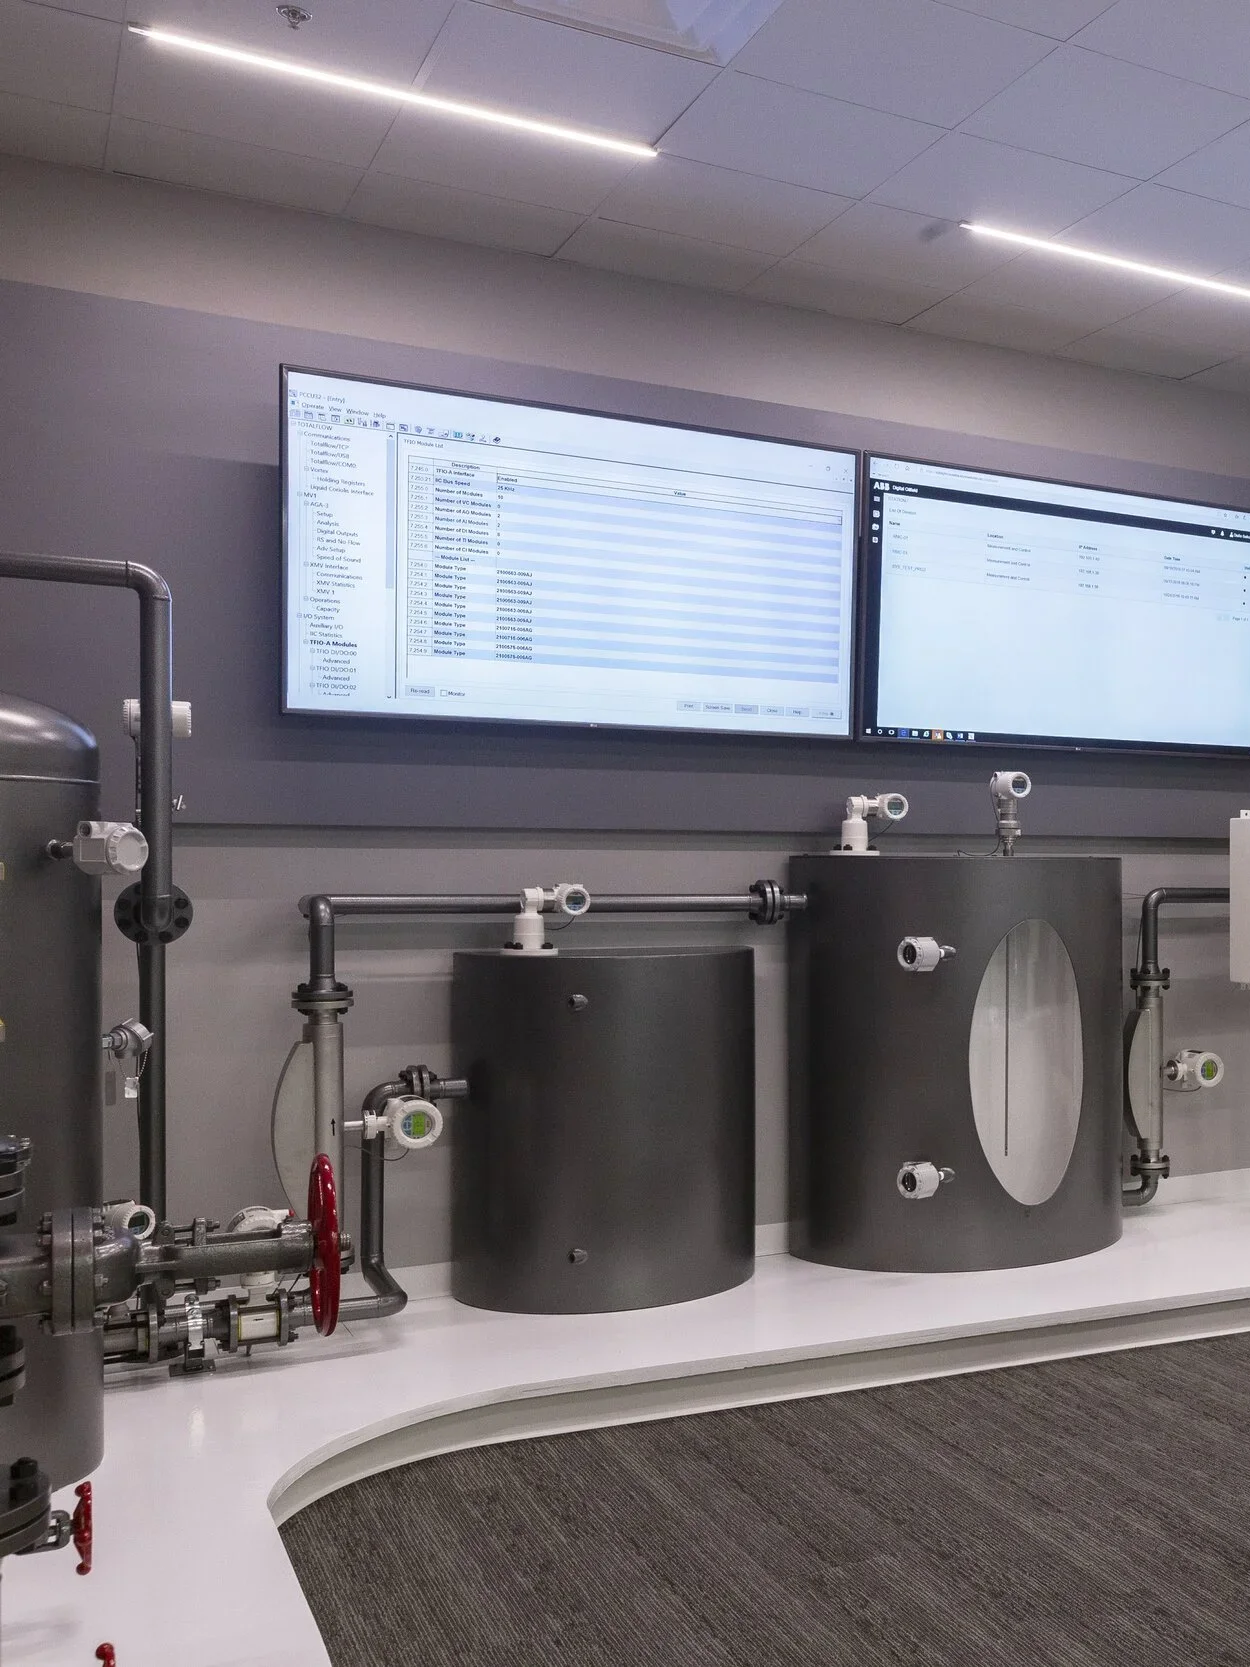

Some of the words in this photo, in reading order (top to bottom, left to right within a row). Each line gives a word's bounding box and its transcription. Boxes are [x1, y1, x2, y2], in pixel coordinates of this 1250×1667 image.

[301, 402, 324, 410] Operate
[346, 408, 368, 416] Window
[297, 421, 332, 431] TOTALFLOW
[303, 431, 350, 442] Communications
[451, 462, 480, 471] Description
[316, 476, 339, 484] Holding
[340, 479, 364, 487] Registers
[350, 488, 373, 496] Interface
[316, 519, 339, 527] Analysis
[316, 571, 362, 580] Communications
[310, 596, 340, 604] Operations
[316, 605, 340, 613] Capacity
